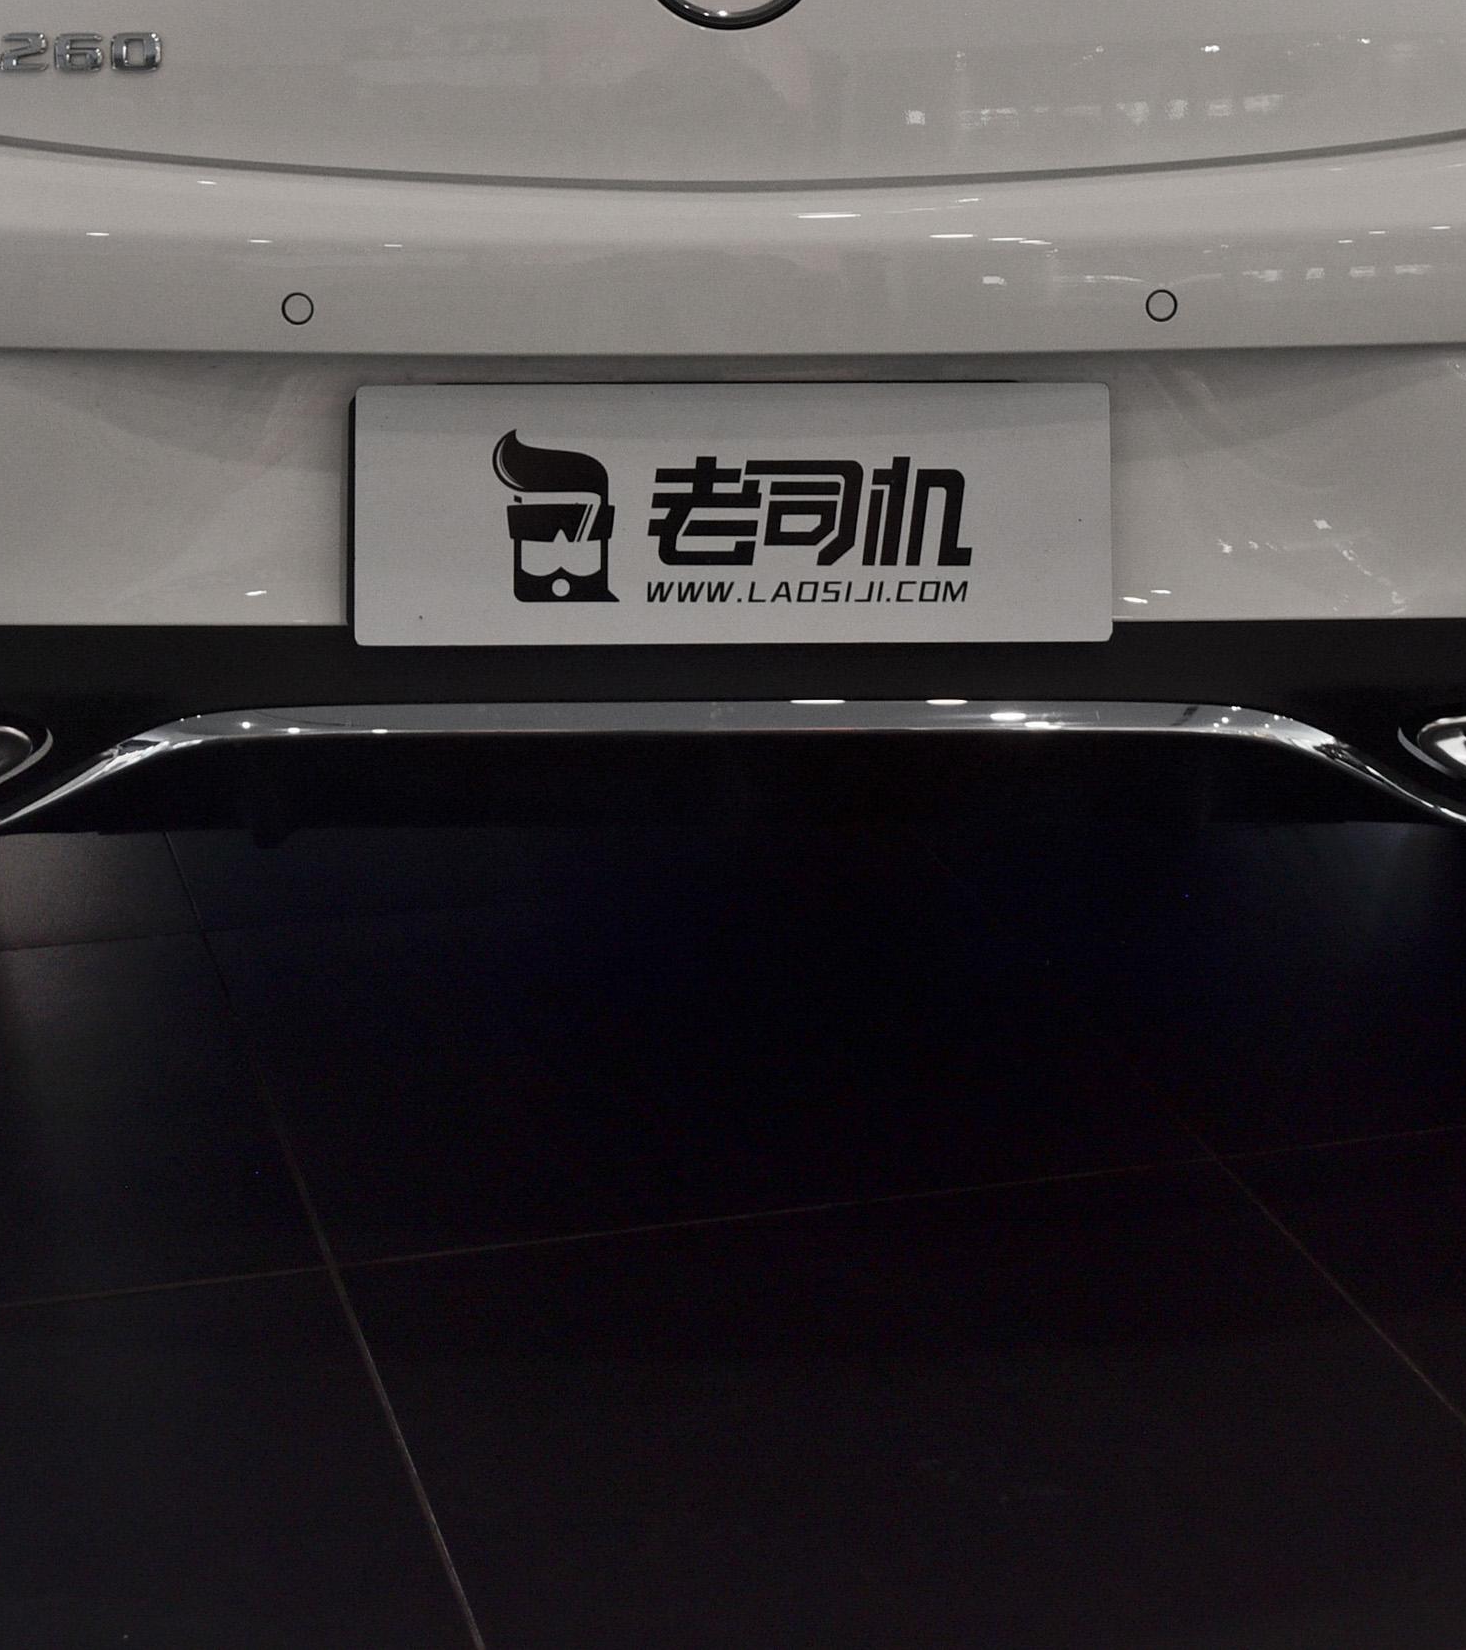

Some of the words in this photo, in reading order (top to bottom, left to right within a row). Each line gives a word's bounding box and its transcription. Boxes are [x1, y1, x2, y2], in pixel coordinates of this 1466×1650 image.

[647, 456, 973, 567] 老司机
[646, 580, 969, 604] WWW.LAOSIJI.COM
